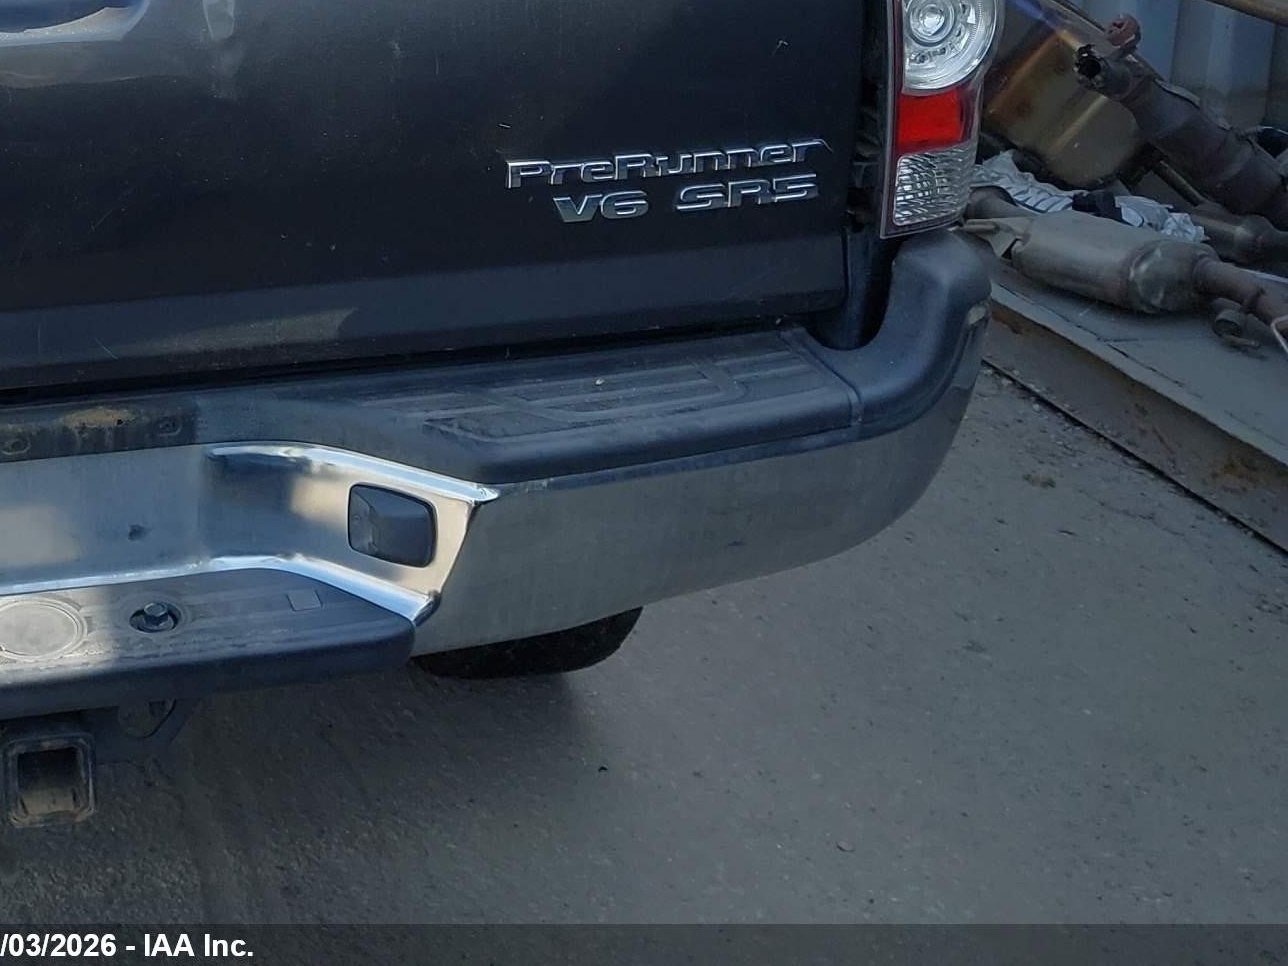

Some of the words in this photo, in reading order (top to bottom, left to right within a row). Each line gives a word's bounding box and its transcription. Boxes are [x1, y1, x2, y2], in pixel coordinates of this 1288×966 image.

[505, 137, 833, 189] PreRunner
[552, 190, 650, 223] V6
[675, 173, 819, 212] SR5
